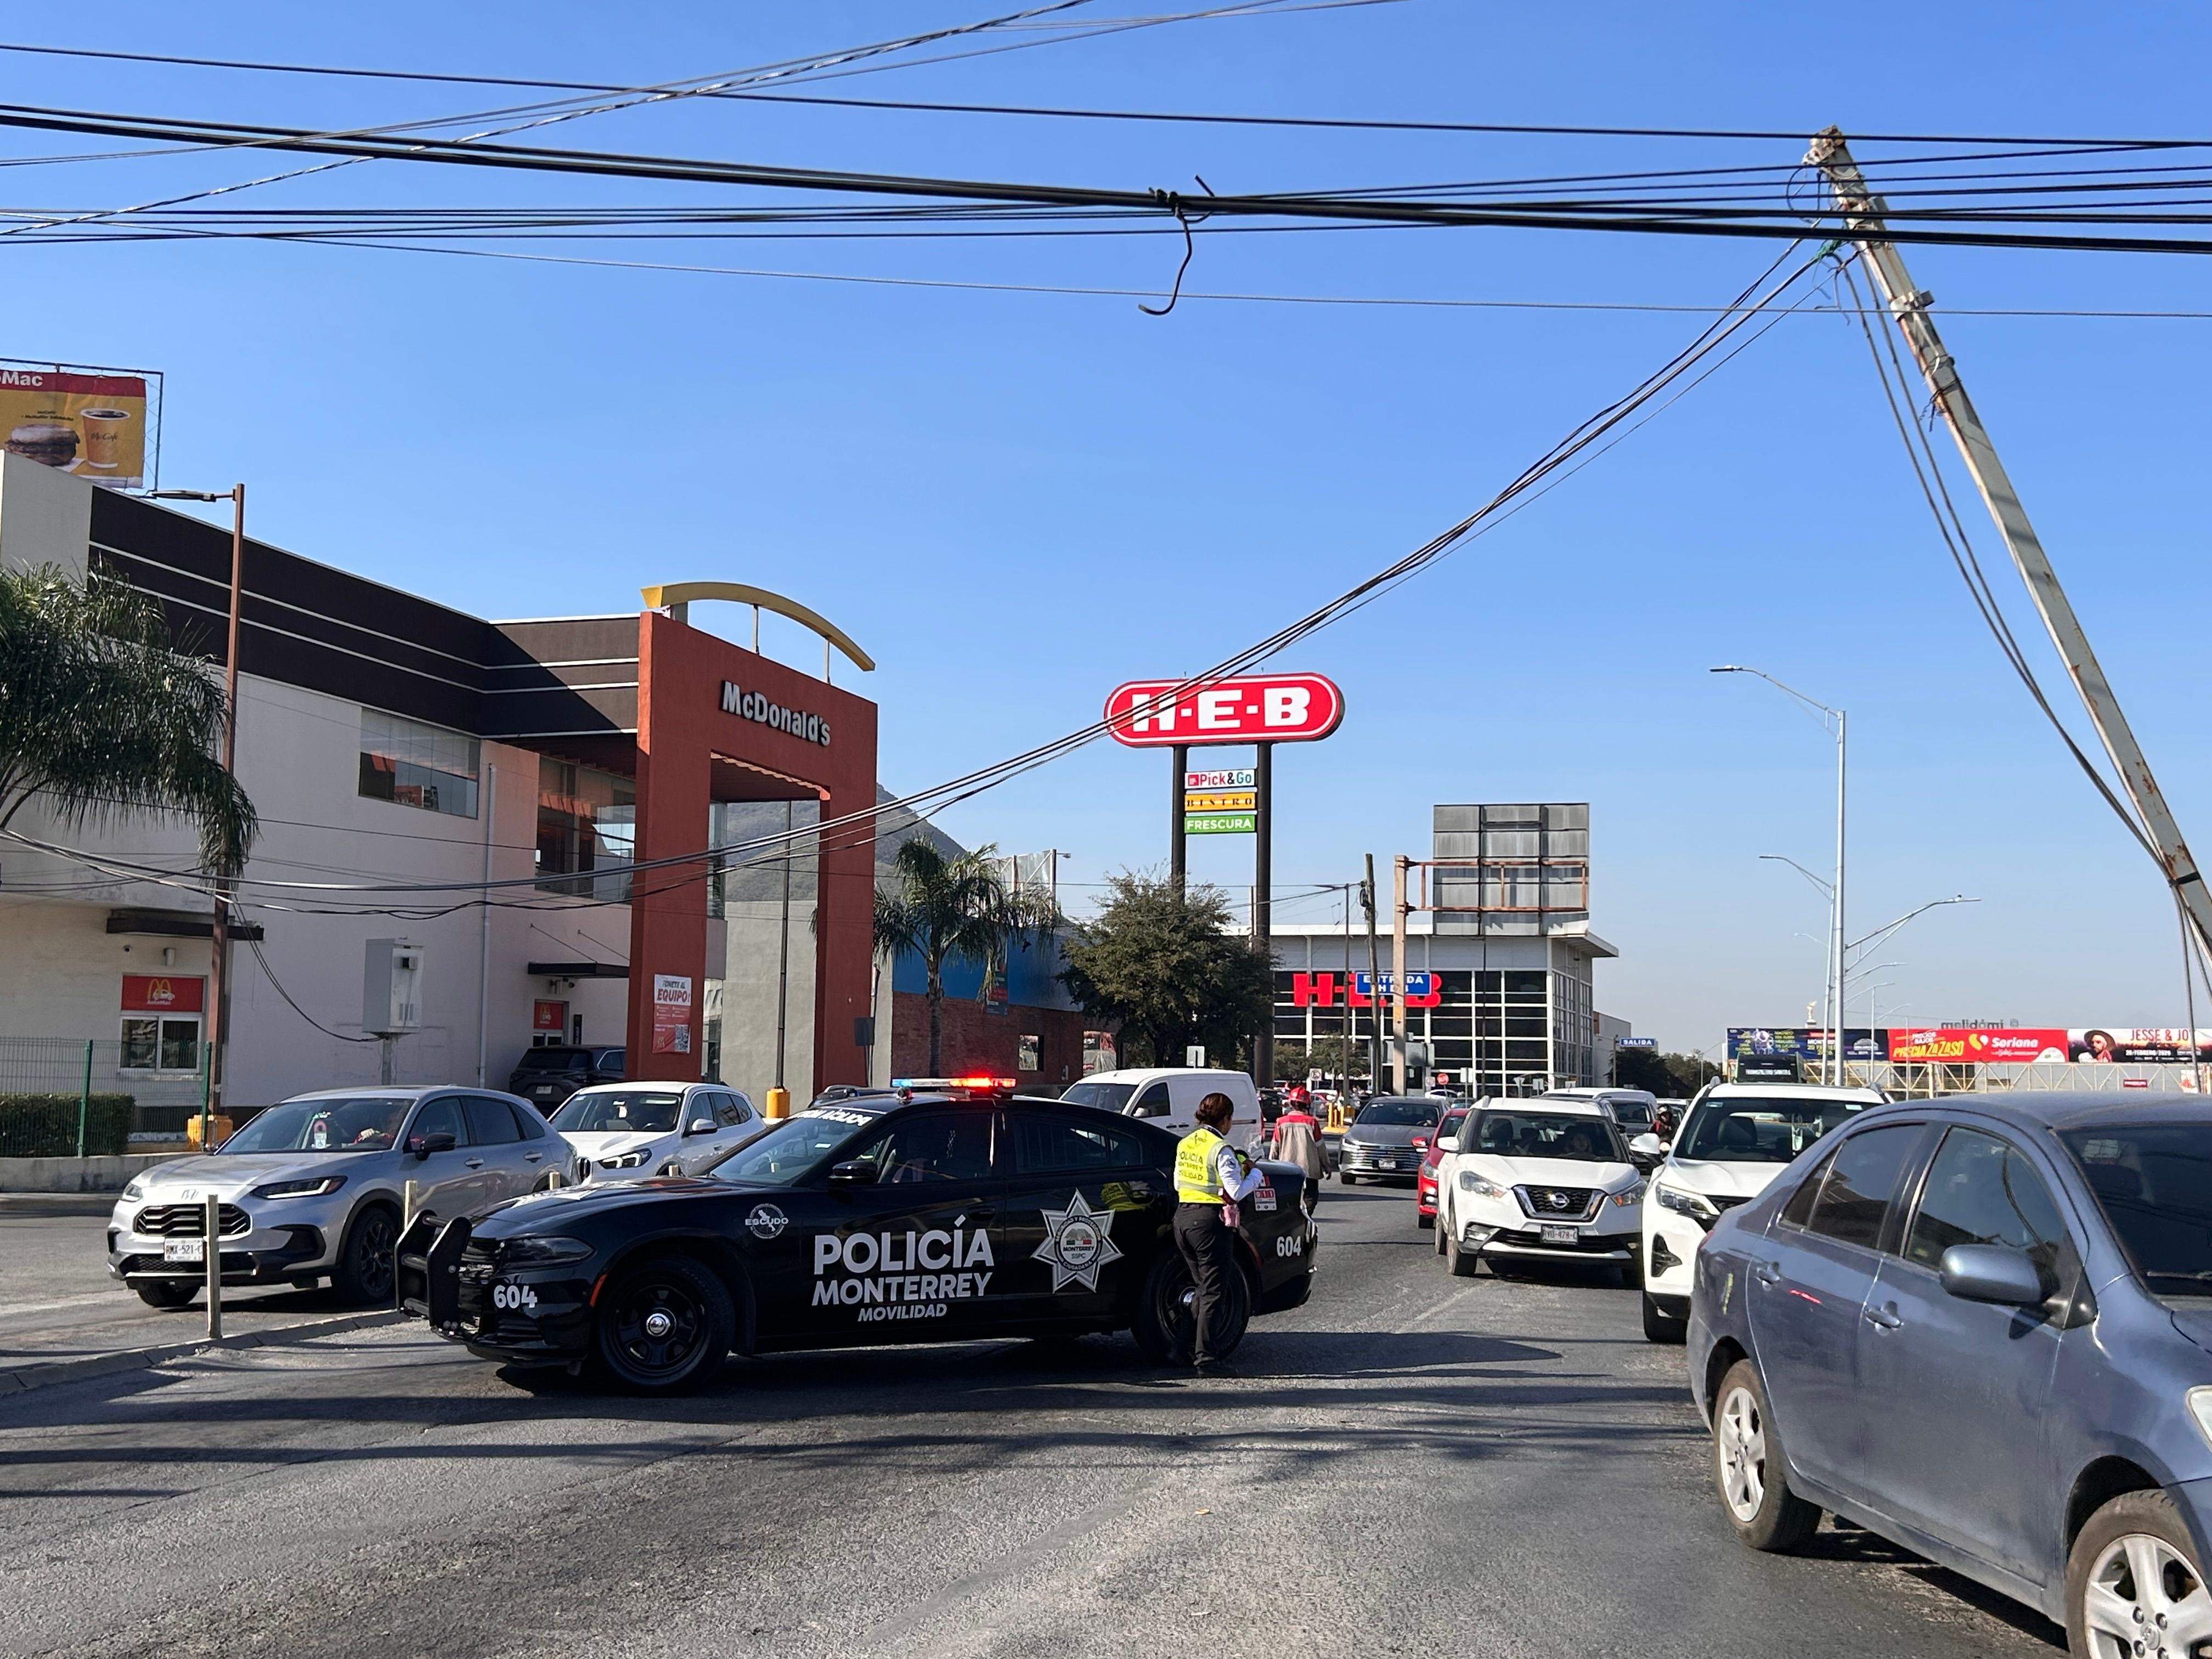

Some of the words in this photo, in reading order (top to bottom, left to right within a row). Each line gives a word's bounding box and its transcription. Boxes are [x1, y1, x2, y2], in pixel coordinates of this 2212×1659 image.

[0, 371, 43, 387] Mac
[721, 680, 832, 747] McDonald's
[1132, 687, 1311, 732] H-E-B
[1200, 772, 1252, 786] Pick&Go
[1187, 798, 1252, 807] BISTRO
[1187, 819, 1252, 830] FRESCURA
[1363, 975, 1424, 984] ETRDA
[657, 988, 691, 1003] EQUIPO!
[1991, 1037, 2039, 1048] Soriana
[2130, 1029, 2160, 1041] JESSE
[2165, 1029, 2172, 1041] &
[2177, 1029, 2189, 1041] JO
[745, 1217, 789, 1226] ESCUDO
[814, 1214, 995, 1274] POLICÍA
[1277, 1235, 1301, 1257] 604
[494, 1284, 538, 1309] 604
[811, 1272, 994, 1306] MONTERREY
[857, 1303, 947, 1322] MOVILIDAD
